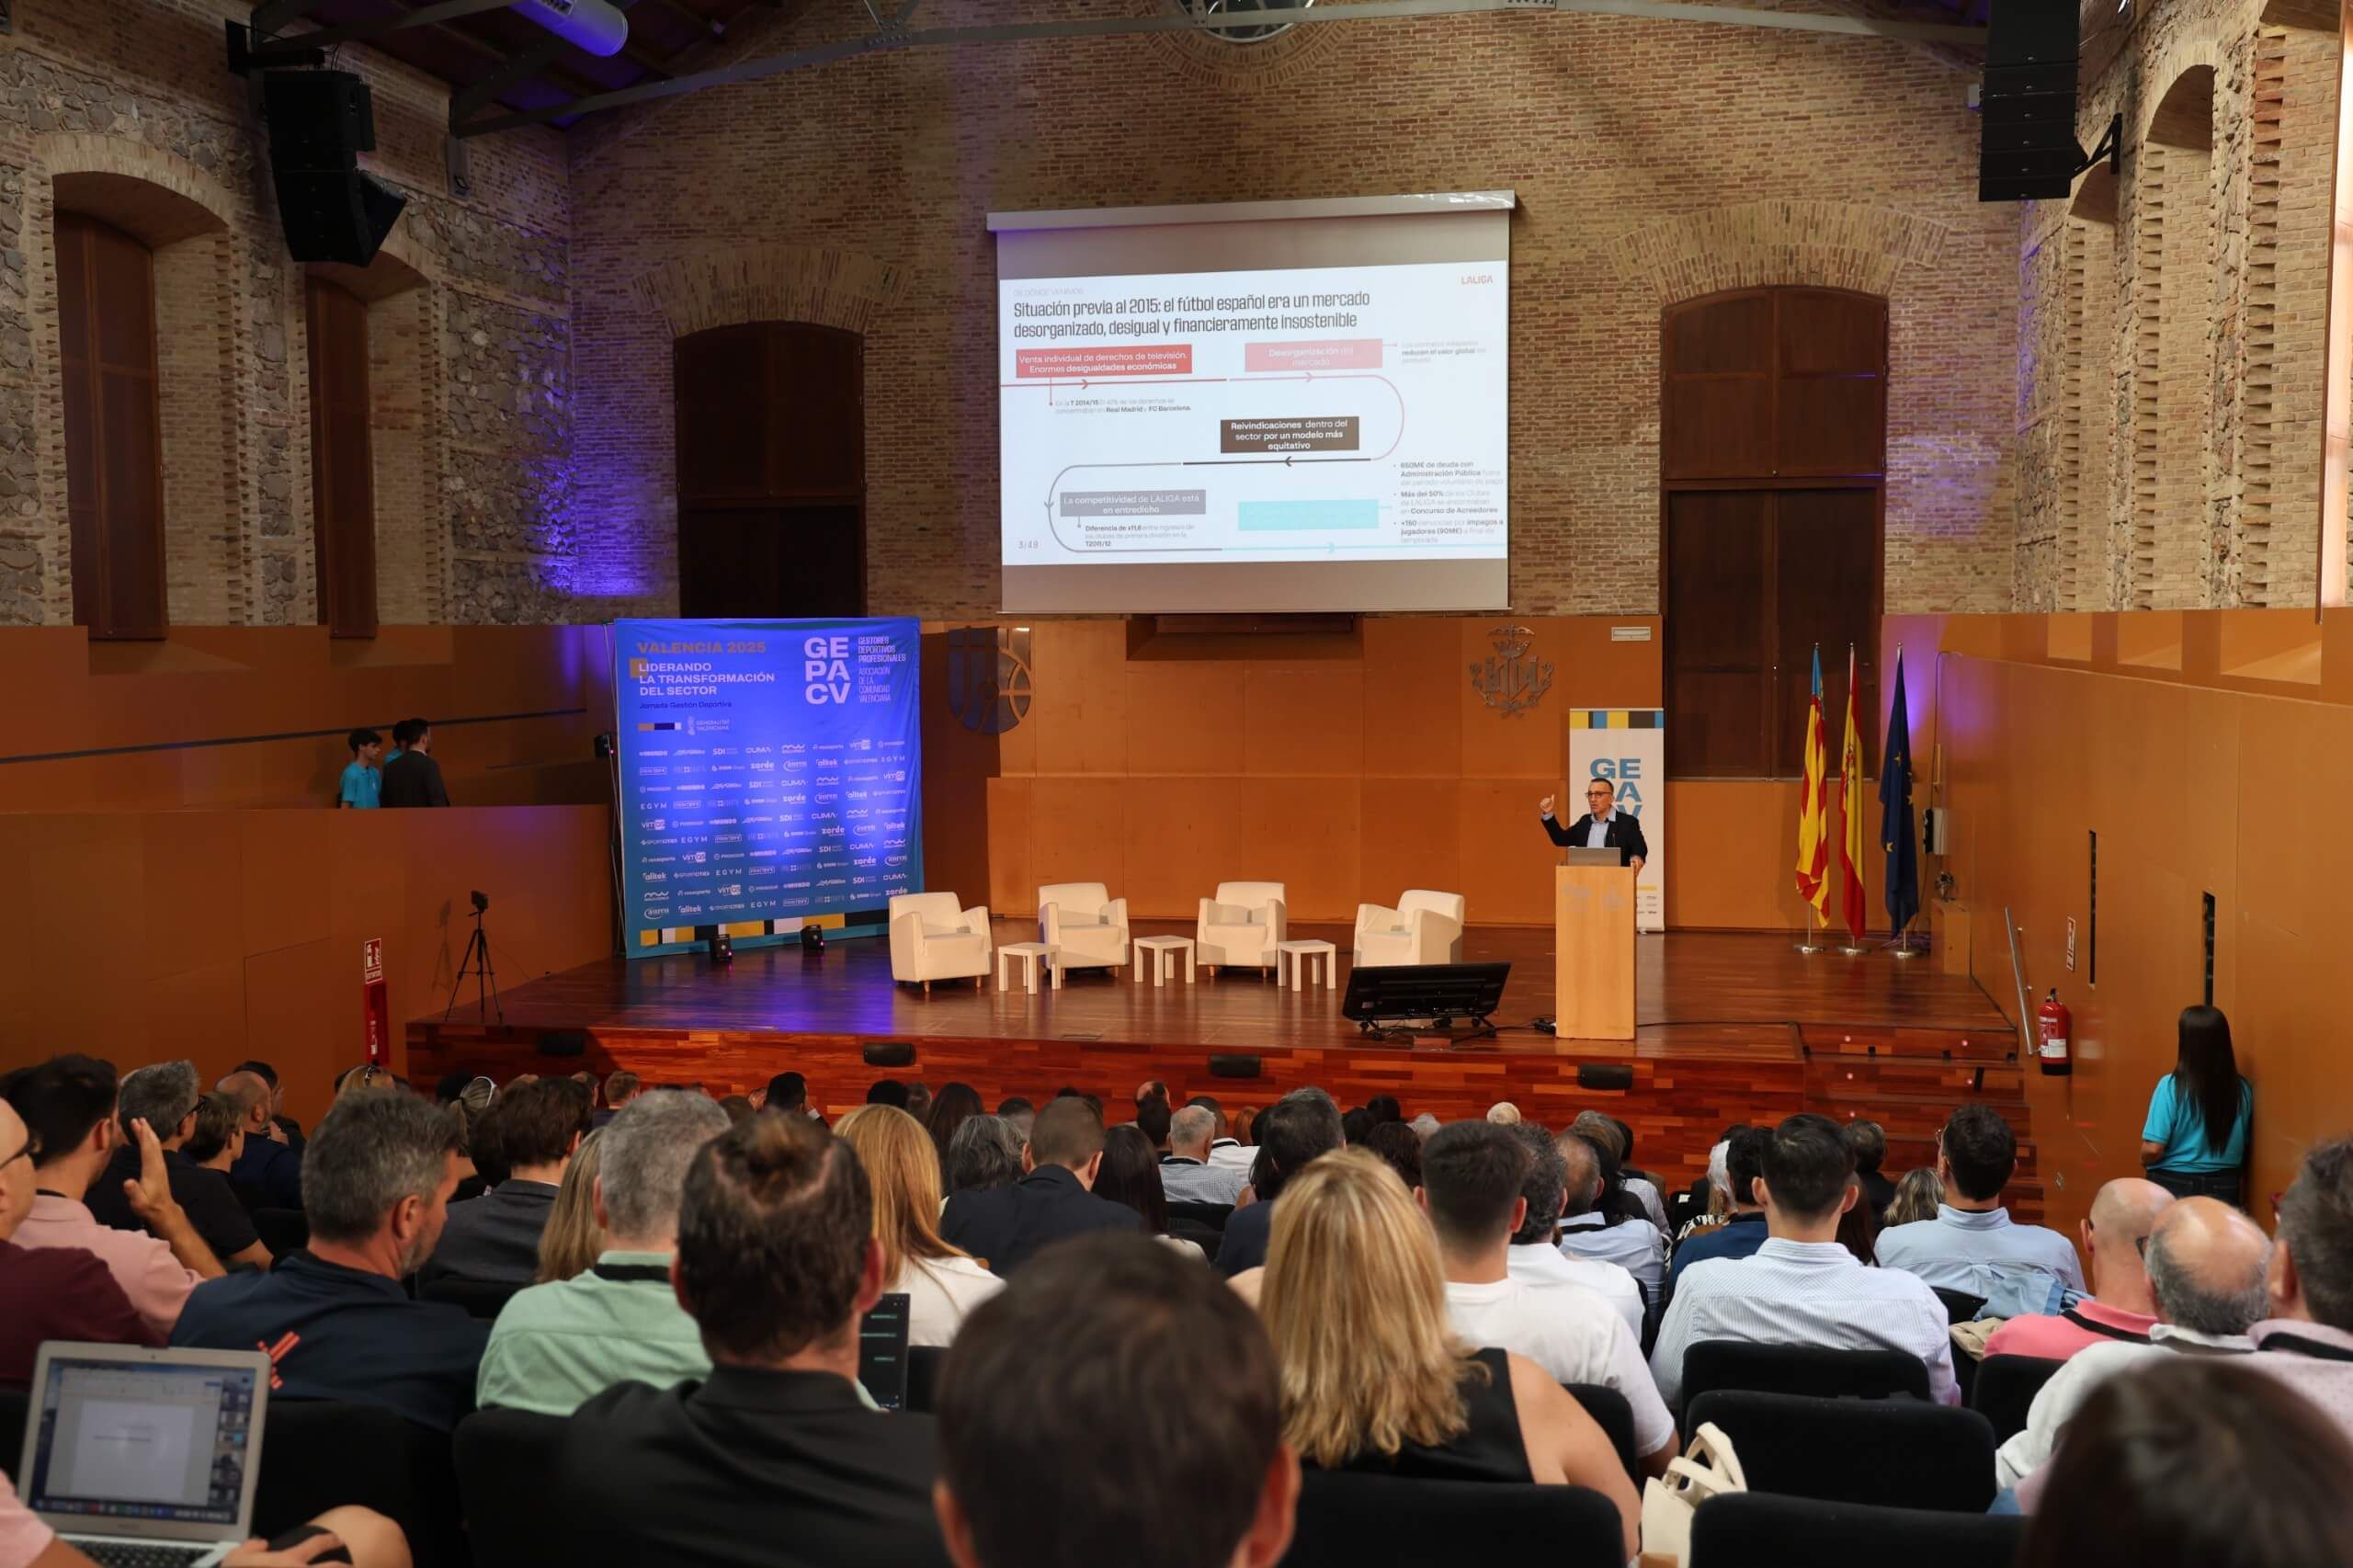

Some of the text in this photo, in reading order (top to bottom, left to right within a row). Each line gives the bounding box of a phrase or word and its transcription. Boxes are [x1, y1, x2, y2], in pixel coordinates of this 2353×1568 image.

[1461, 275, 1494, 285] LALIGA
[1014, 290, 1370, 318] Situación previa al 2015: el fútbol español era un mercado
[1014, 312, 1358, 339] desorganizado, desigual y financieramente insostenible
[1018, 356, 1042, 364] Venta
[1044, 354, 1081, 363] individual
[1083, 354, 1094, 362] de
[1096, 353, 1133, 361] derechos
[1135, 353, 1145, 361] de
[1029, 362, 1176, 374] Enormes desigualdades económicas
[1231, 419, 1347, 430] Reivindicaciones dentro del
[1264, 433, 1279, 442] por
[1292, 431, 1324, 439] modelo
[1325, 430, 1343, 438] más
[1267, 442, 1311, 452] equitativo
[1074, 495, 1137, 506] competitividad
[1139, 495, 1148, 504] de
[1150, 494, 1180, 503] LALIGA
[1182, 493, 1199, 502] está
[1115, 506, 1160, 515] entredicho
[638, 642, 766, 654] VALENCIA 2025
[804, 637, 849, 659] GE
[639, 663, 711, 672] LIDERANDO
[805, 660, 851, 682] PA
[639, 672, 775, 684] LA TRANSFORMACIÓN
[640, 686, 717, 696] DEL SECTOR
[805, 683, 851, 704] CV
[1589, 758, 1641, 779] GE
